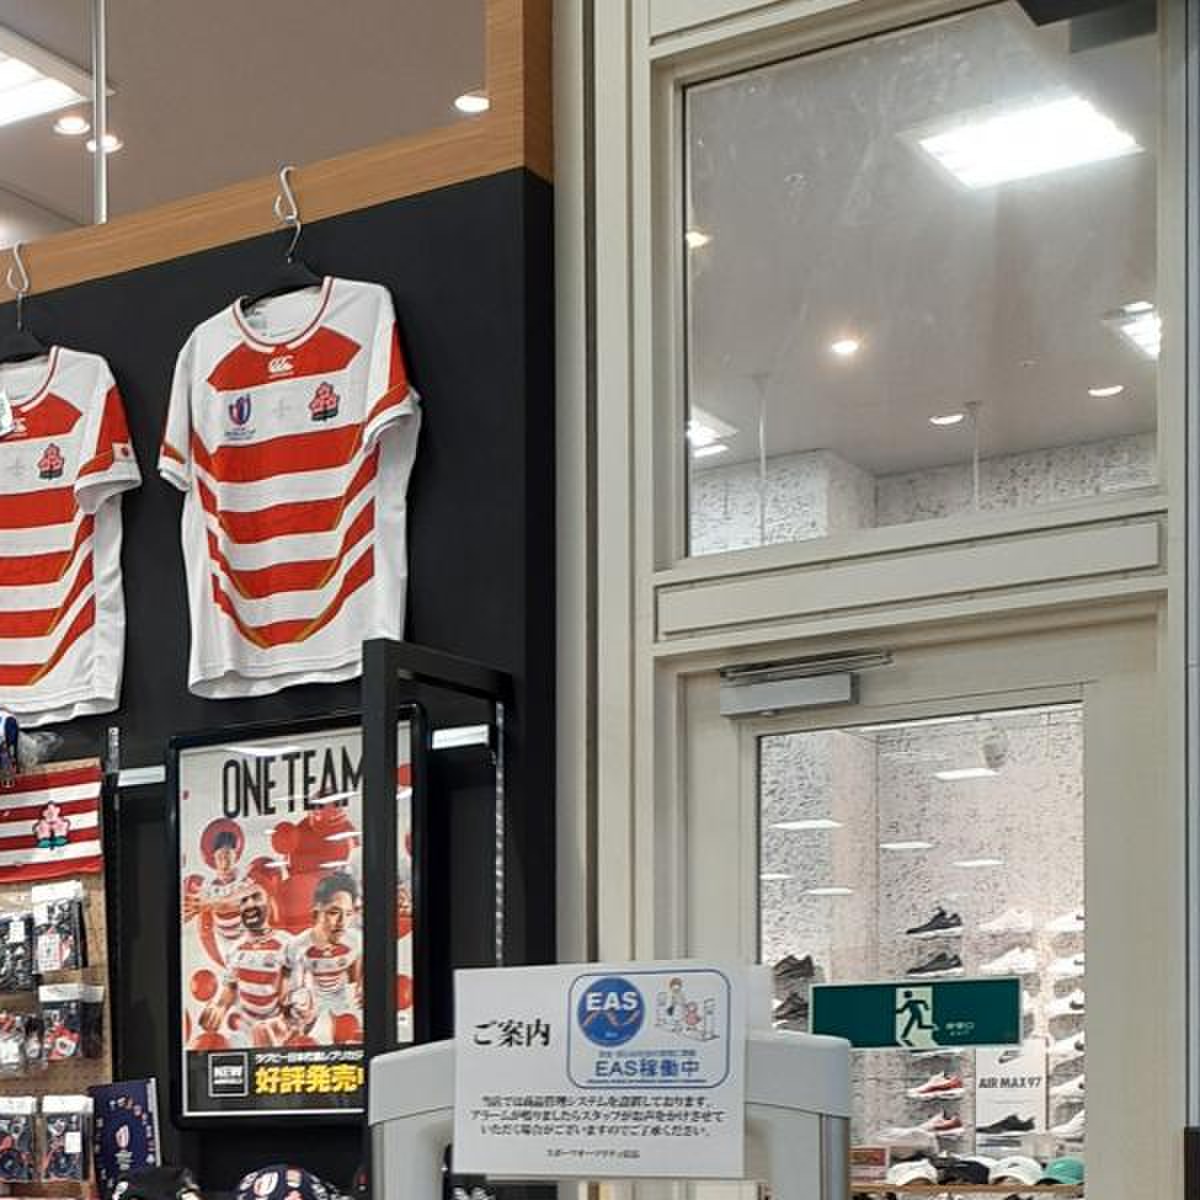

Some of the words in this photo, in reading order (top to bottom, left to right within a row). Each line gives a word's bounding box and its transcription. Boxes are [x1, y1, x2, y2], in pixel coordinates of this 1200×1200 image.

[222, 755, 276, 819] ONE
[281, 745, 364, 813] TEAM
[586, 991, 639, 1011] EAS
[473, 1019, 550, 1047] ご案内
[979, 1077, 998, 1089] AIR
[1000, 1077, 1026, 1089] MAX
[1027, 1076, 1041, 1089] 97
